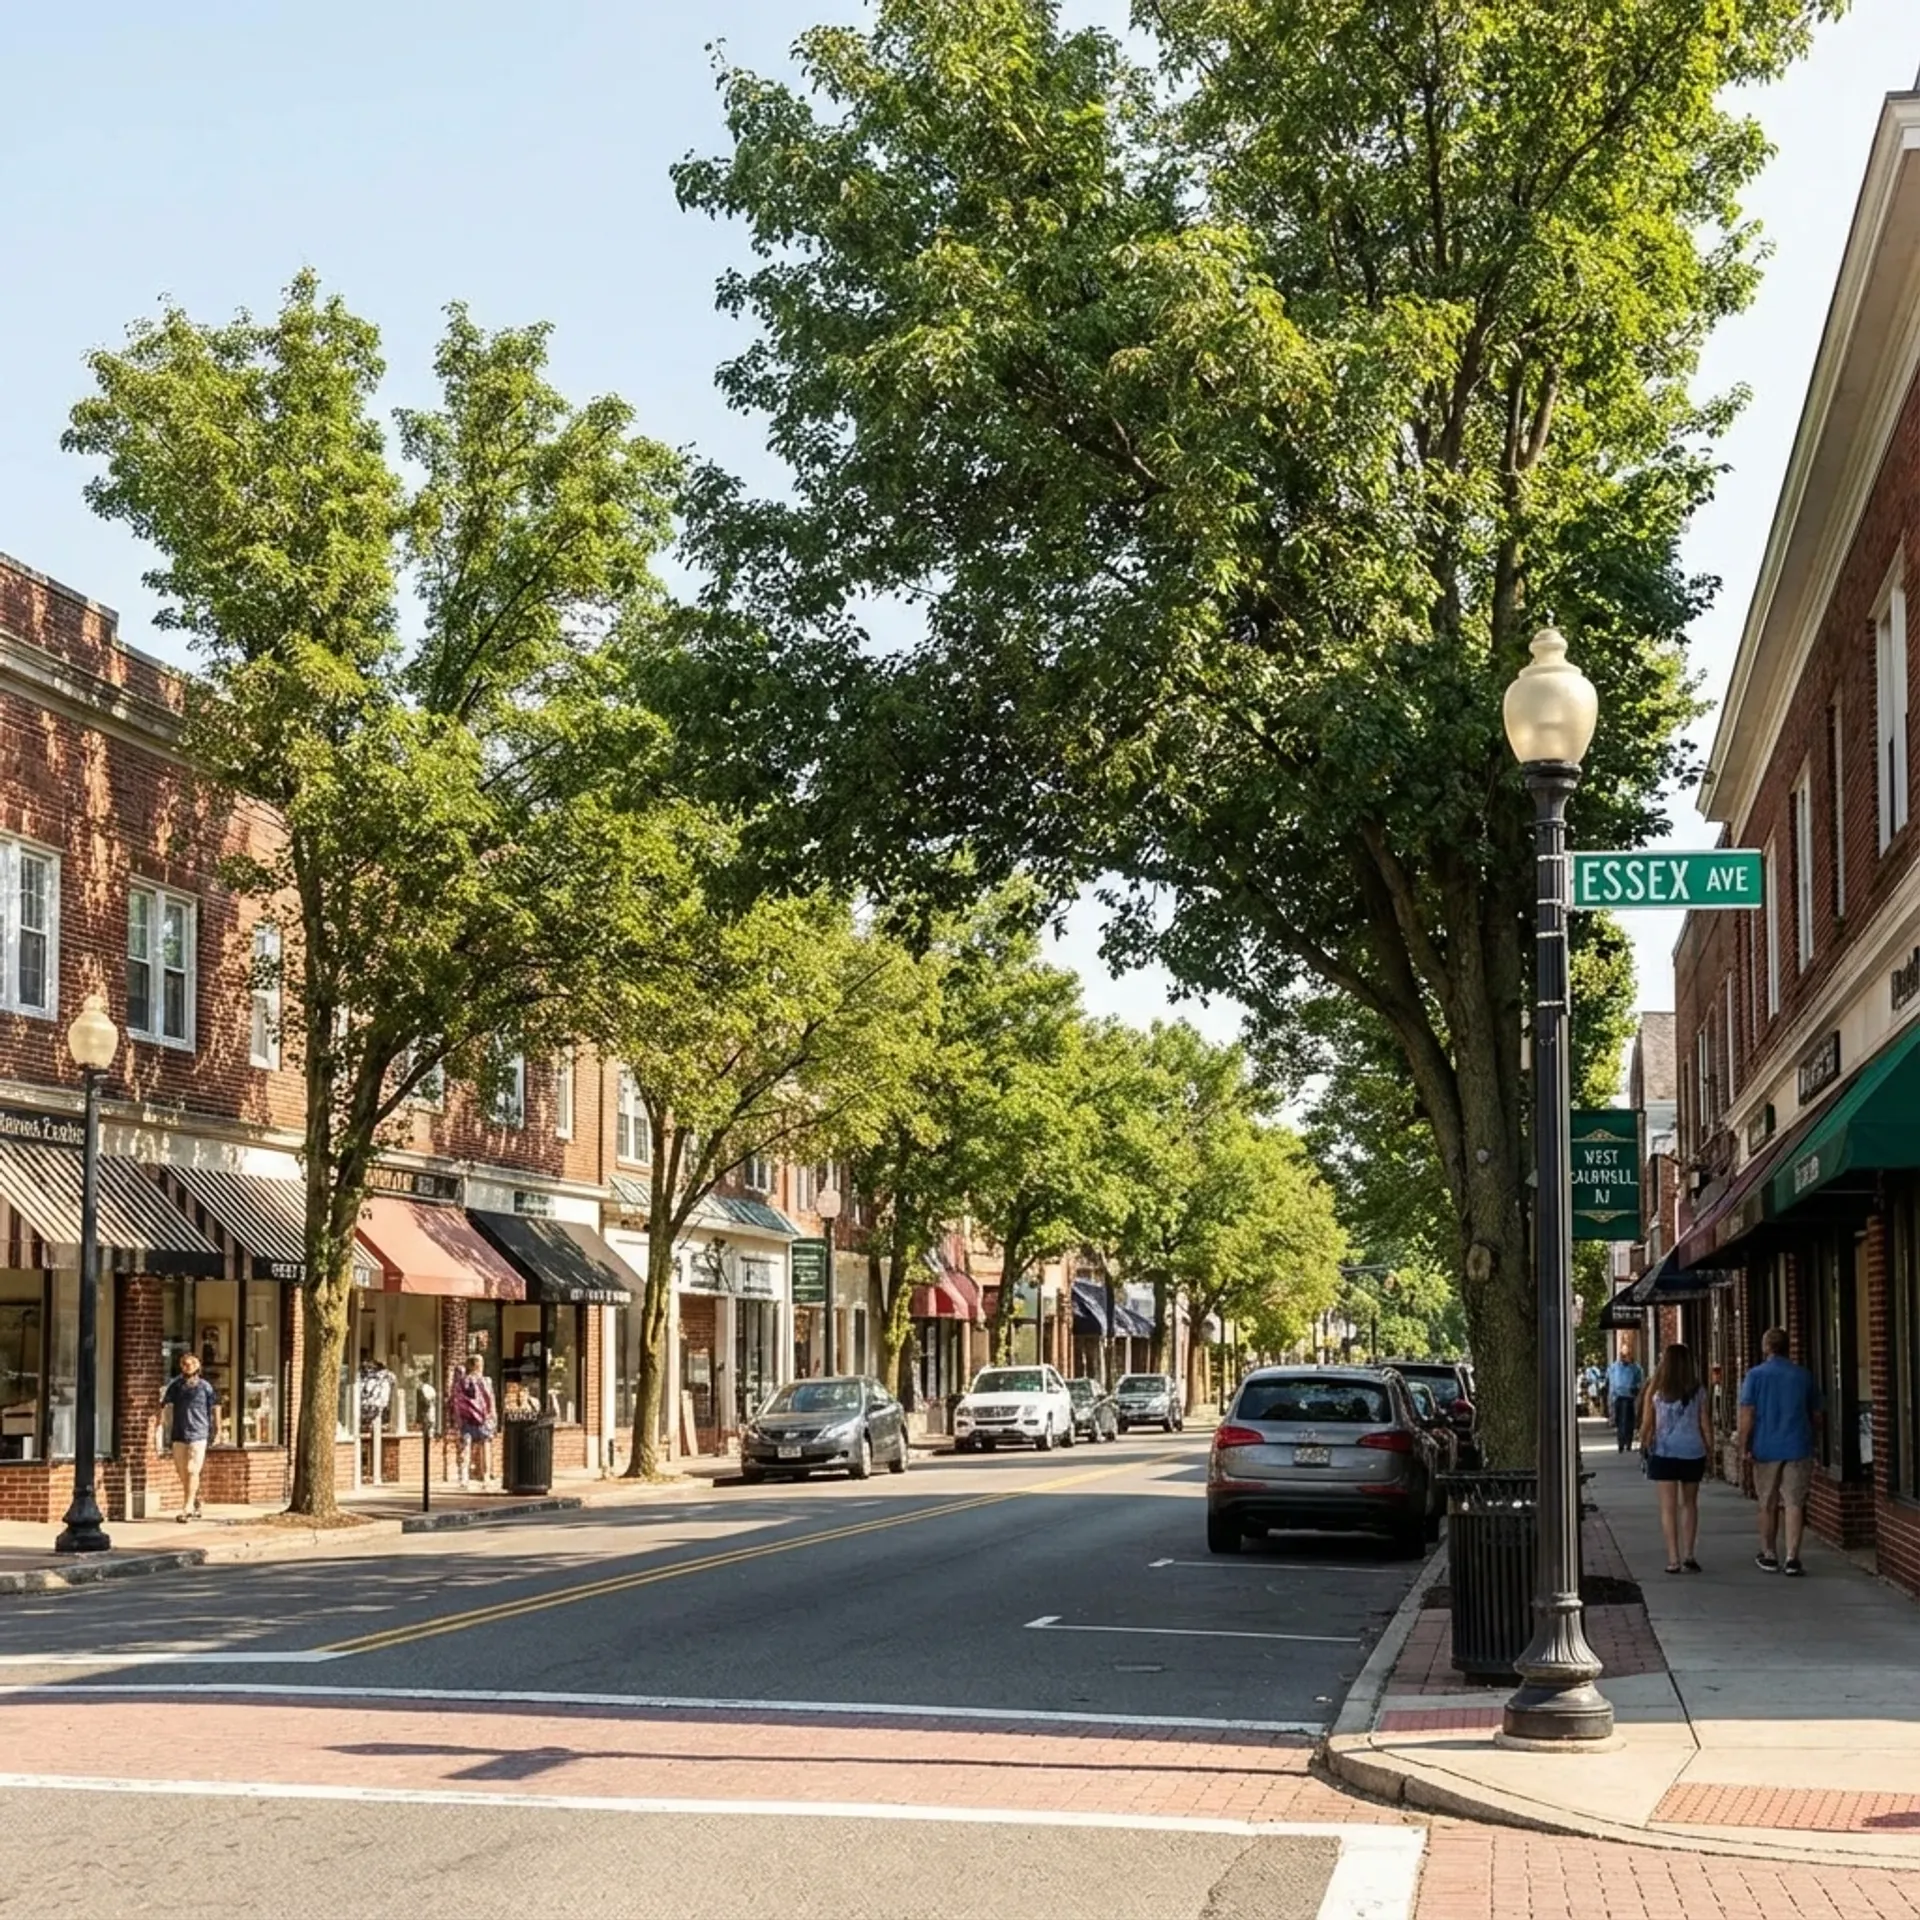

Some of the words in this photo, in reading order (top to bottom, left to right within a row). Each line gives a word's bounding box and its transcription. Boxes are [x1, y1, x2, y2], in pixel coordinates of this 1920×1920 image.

[1582, 860, 1690, 901] ESSEX
[1706, 866, 1749, 892] AVE
[1584, 1149, 1618, 1165] WEST
